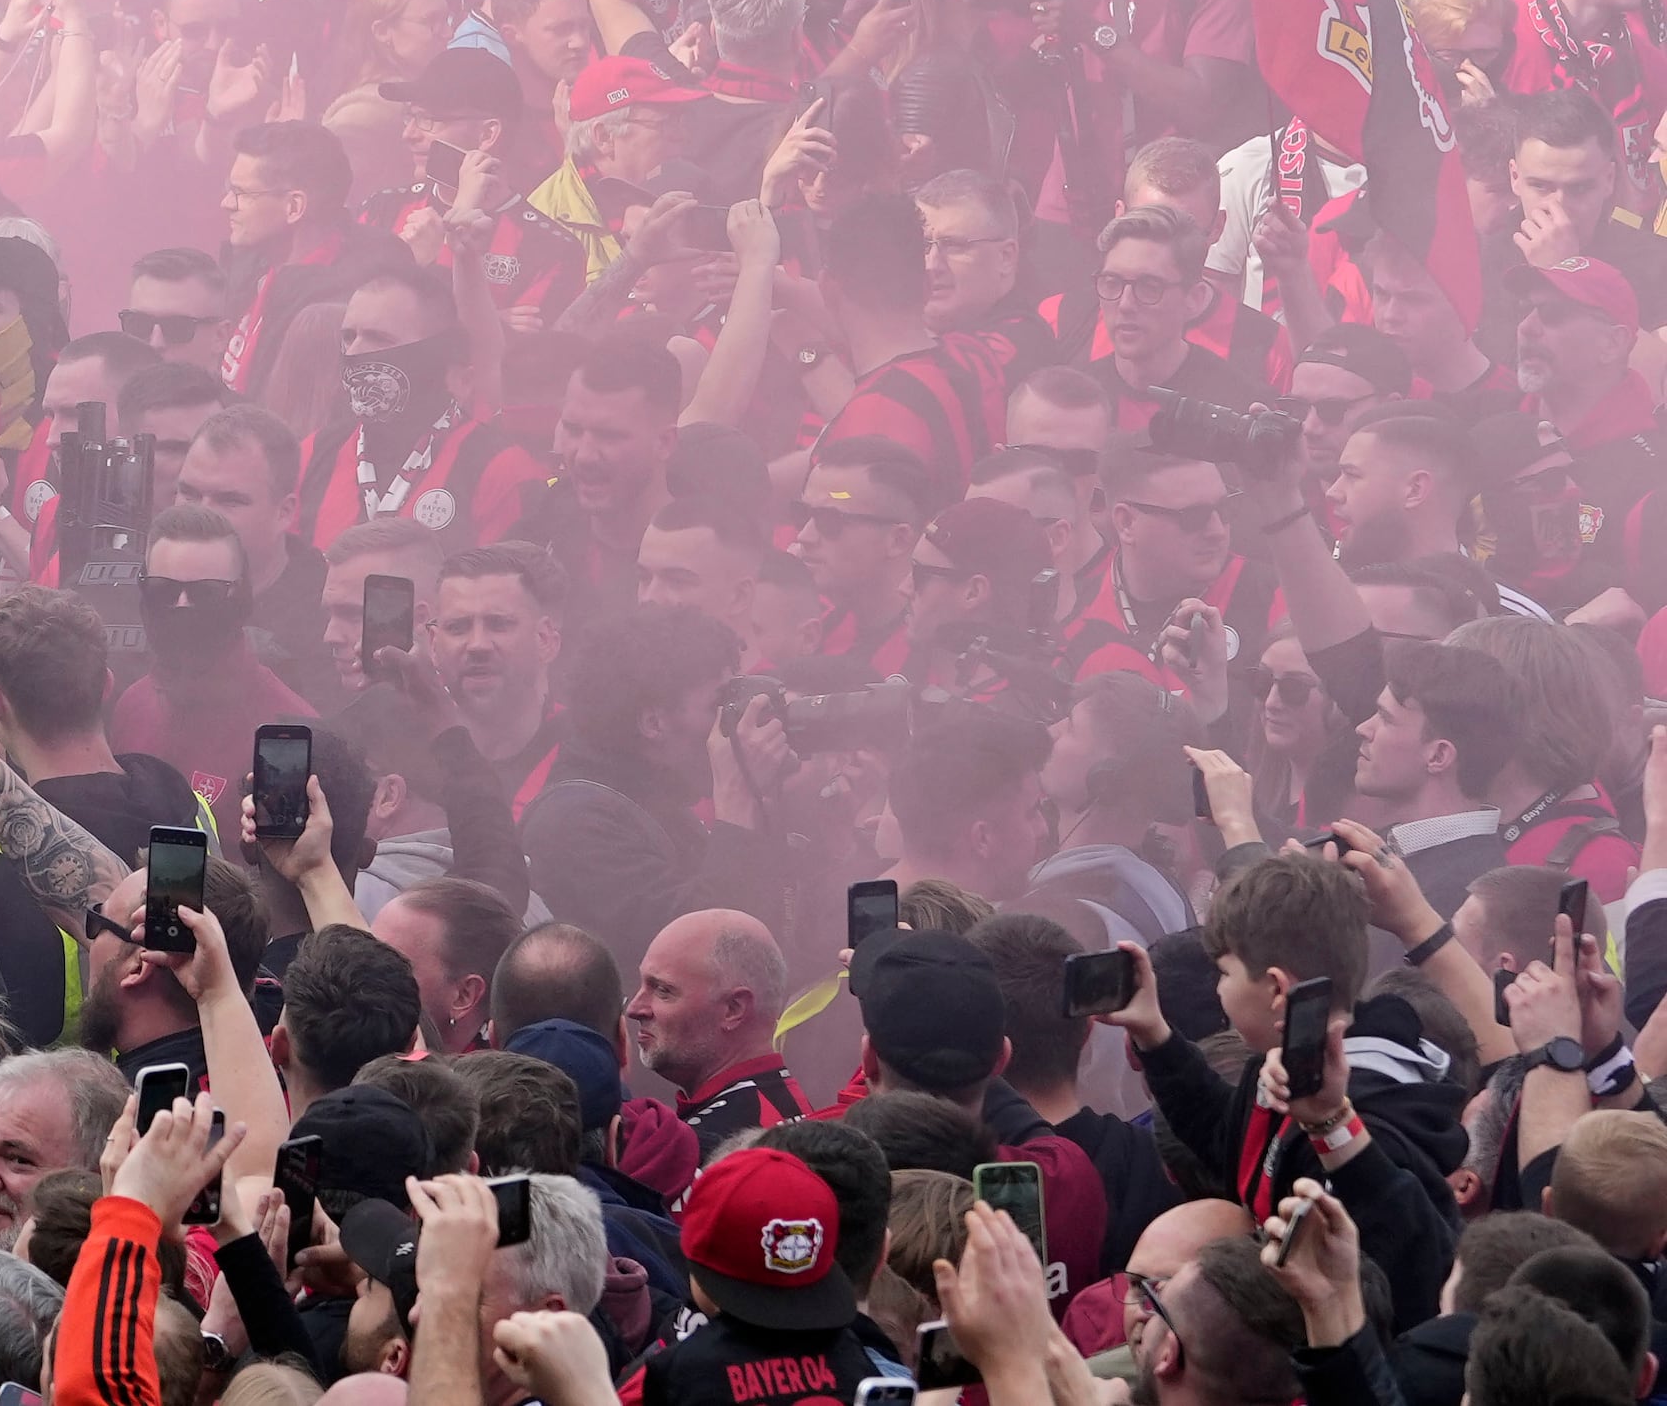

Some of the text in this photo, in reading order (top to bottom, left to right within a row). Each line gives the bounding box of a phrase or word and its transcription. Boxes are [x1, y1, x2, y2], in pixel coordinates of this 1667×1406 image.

[607, 88, 630, 104] 1904
[1520, 800, 1550, 824] Bayer
[727, 1355, 837, 1402] BAYER 04
